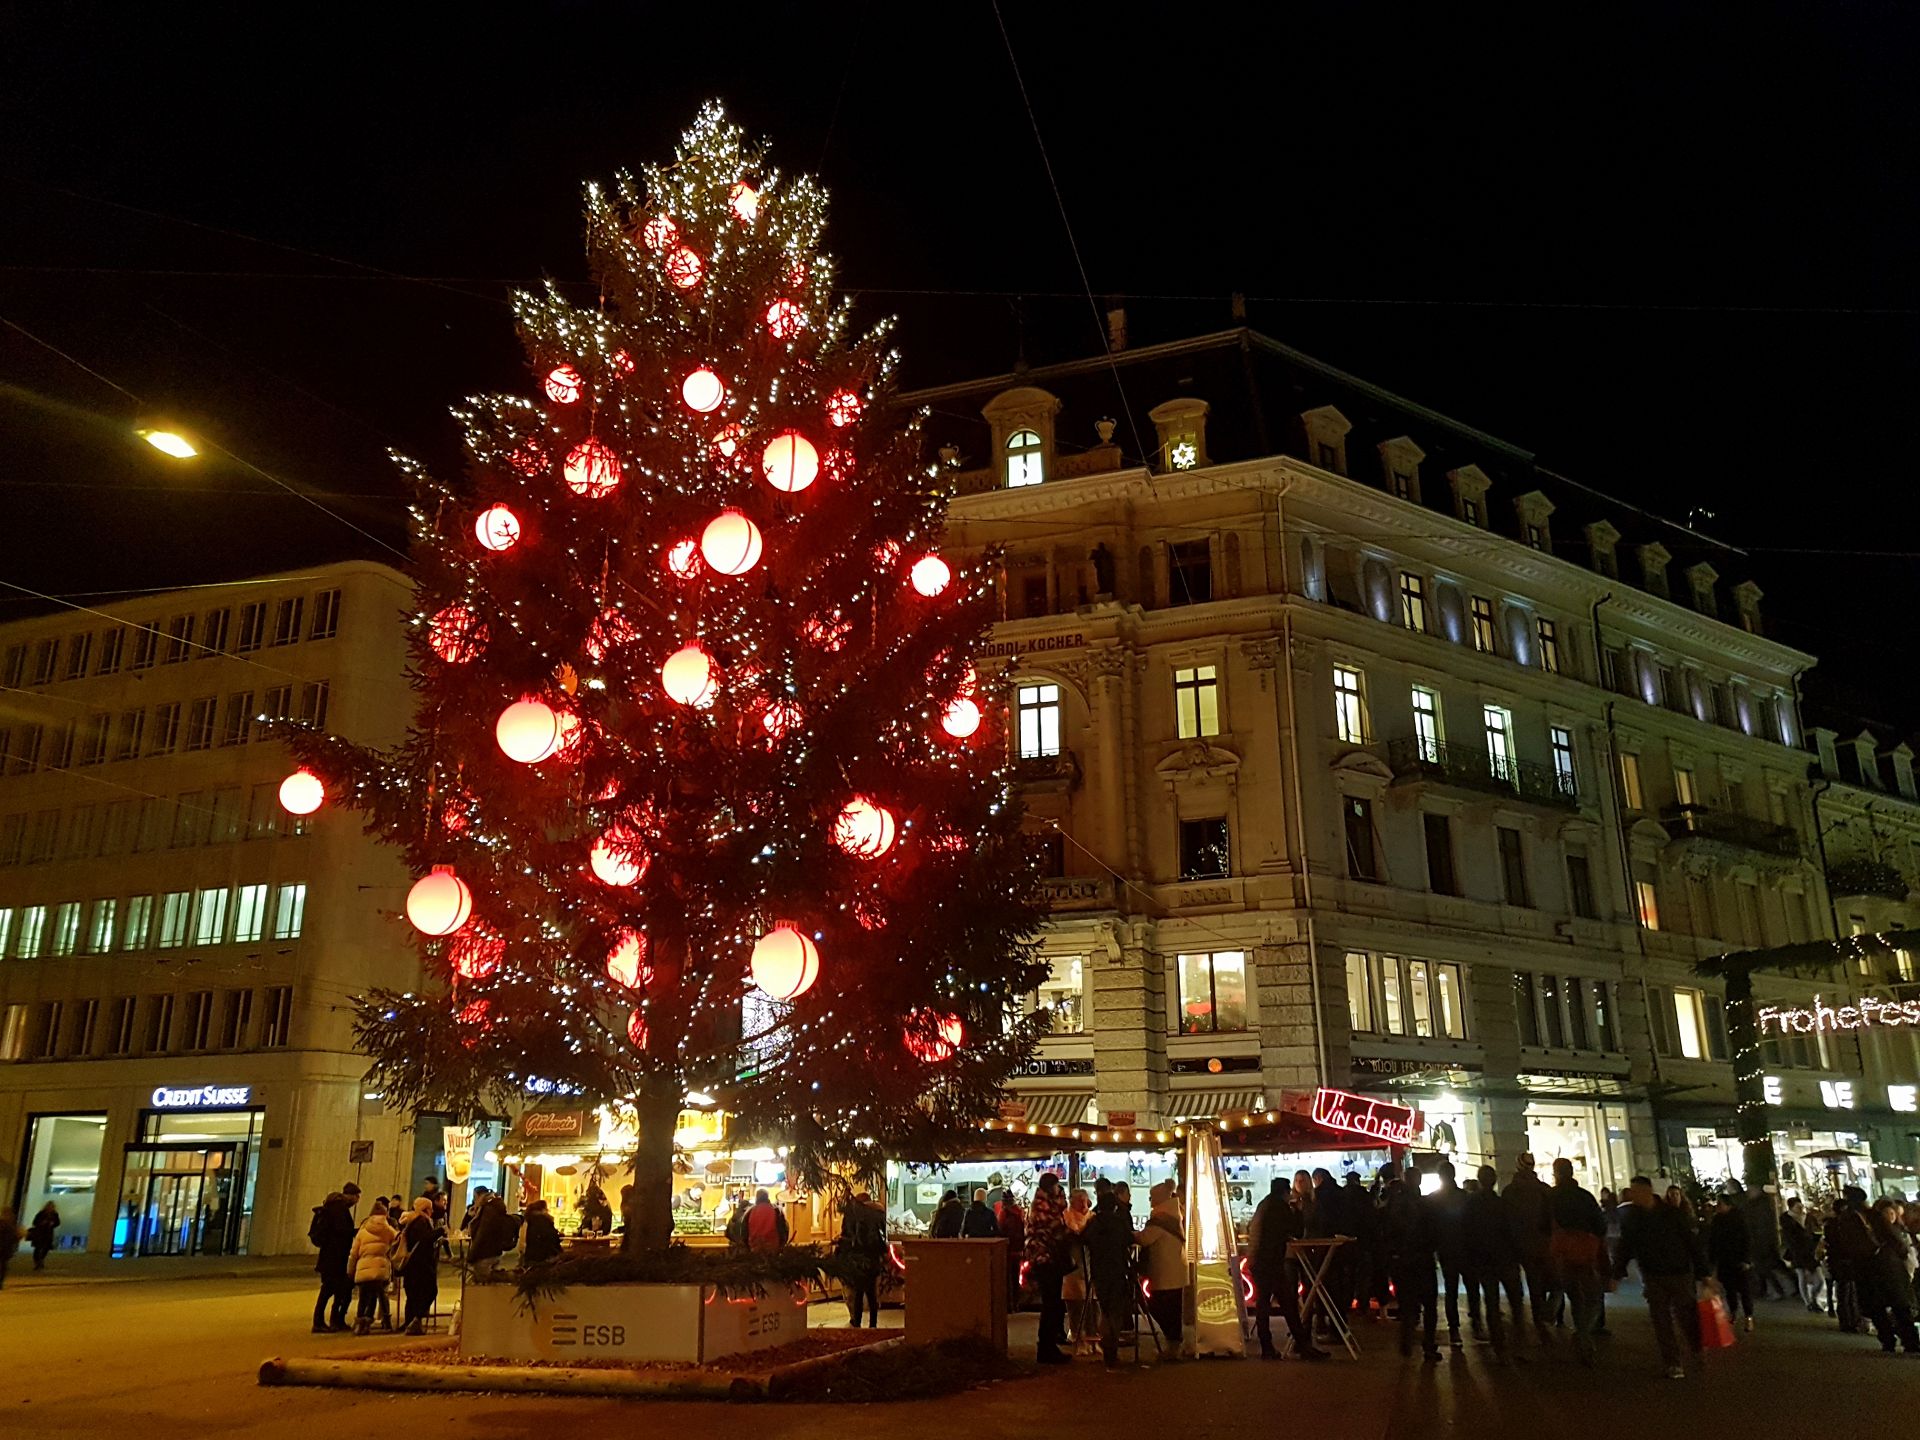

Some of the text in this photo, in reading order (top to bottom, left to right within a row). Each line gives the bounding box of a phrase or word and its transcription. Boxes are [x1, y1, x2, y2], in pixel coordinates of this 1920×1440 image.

[1759, 994, 1861, 1035] Frohe
[152, 1085, 250, 1107] CREDIT SUISSE
[526, 1112, 577, 1137] Glühwein
[761, 1312, 781, 1333] ESB
[583, 1325, 625, 1346] ESB
